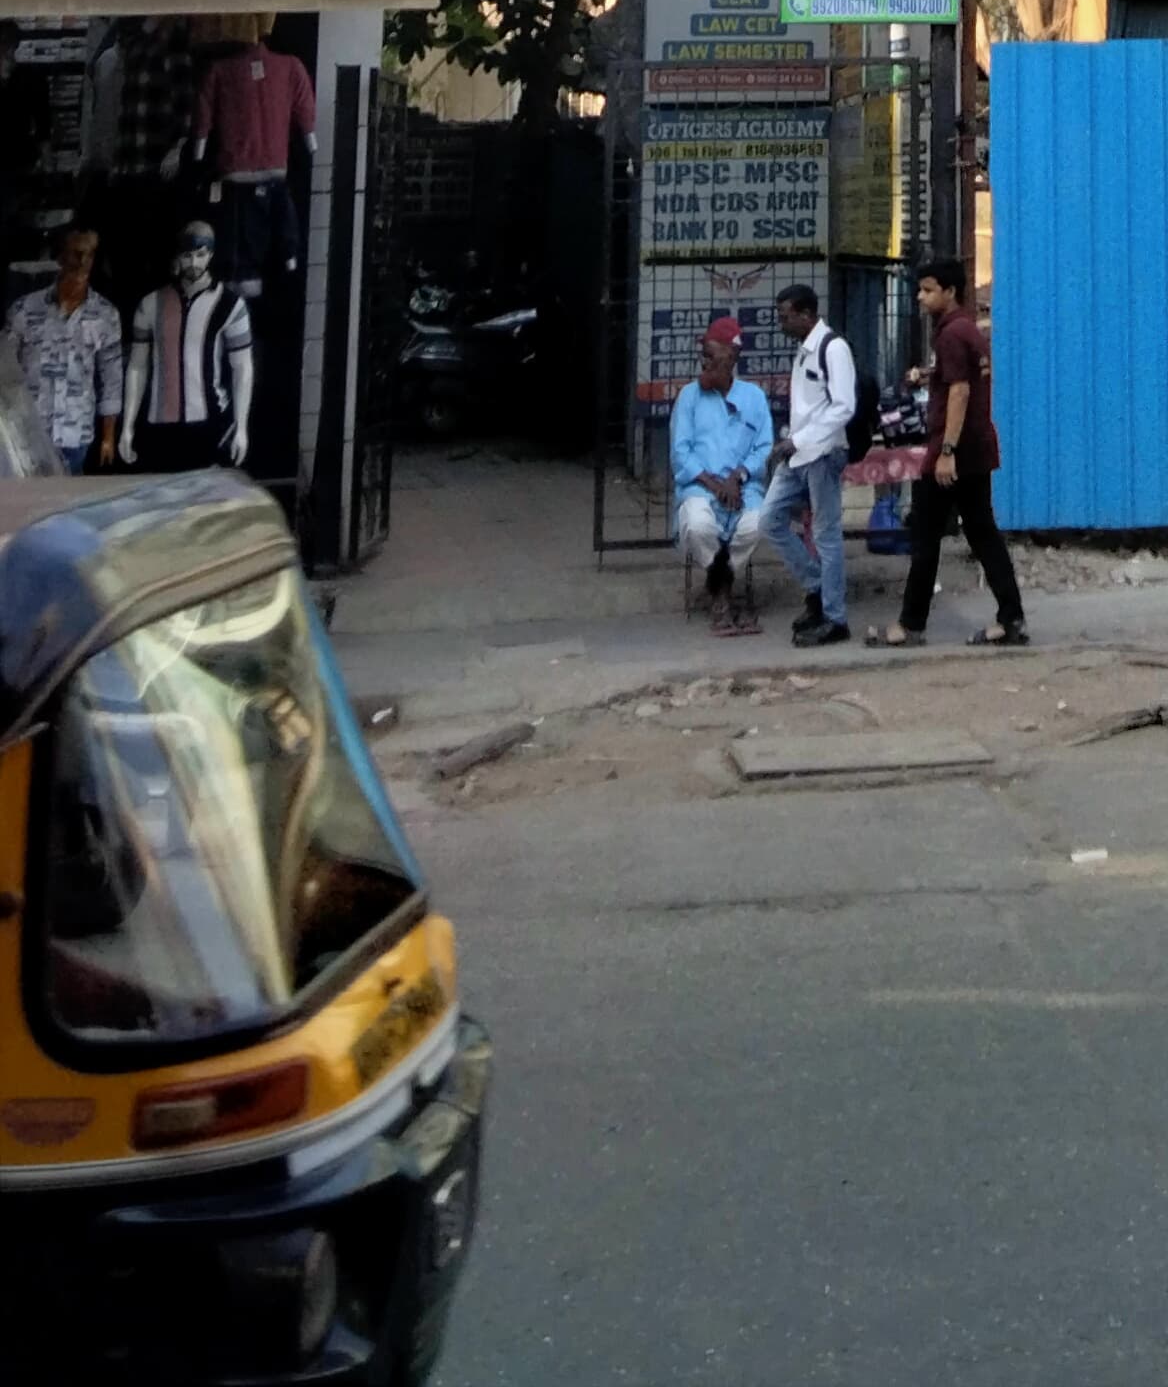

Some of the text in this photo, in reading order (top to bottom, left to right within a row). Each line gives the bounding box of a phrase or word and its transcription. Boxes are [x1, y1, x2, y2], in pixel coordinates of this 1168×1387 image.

[699, 18, 779, 33] LAW CET
[668, 43, 808, 60] LAW SEMESTER
[736, 120, 826, 138] ACADEMY
[654, 161, 819, 186] UPSC MPSC
[654, 191, 820, 214] NDA CDS AFCAT
[752, 217, 817, 239] SSC
